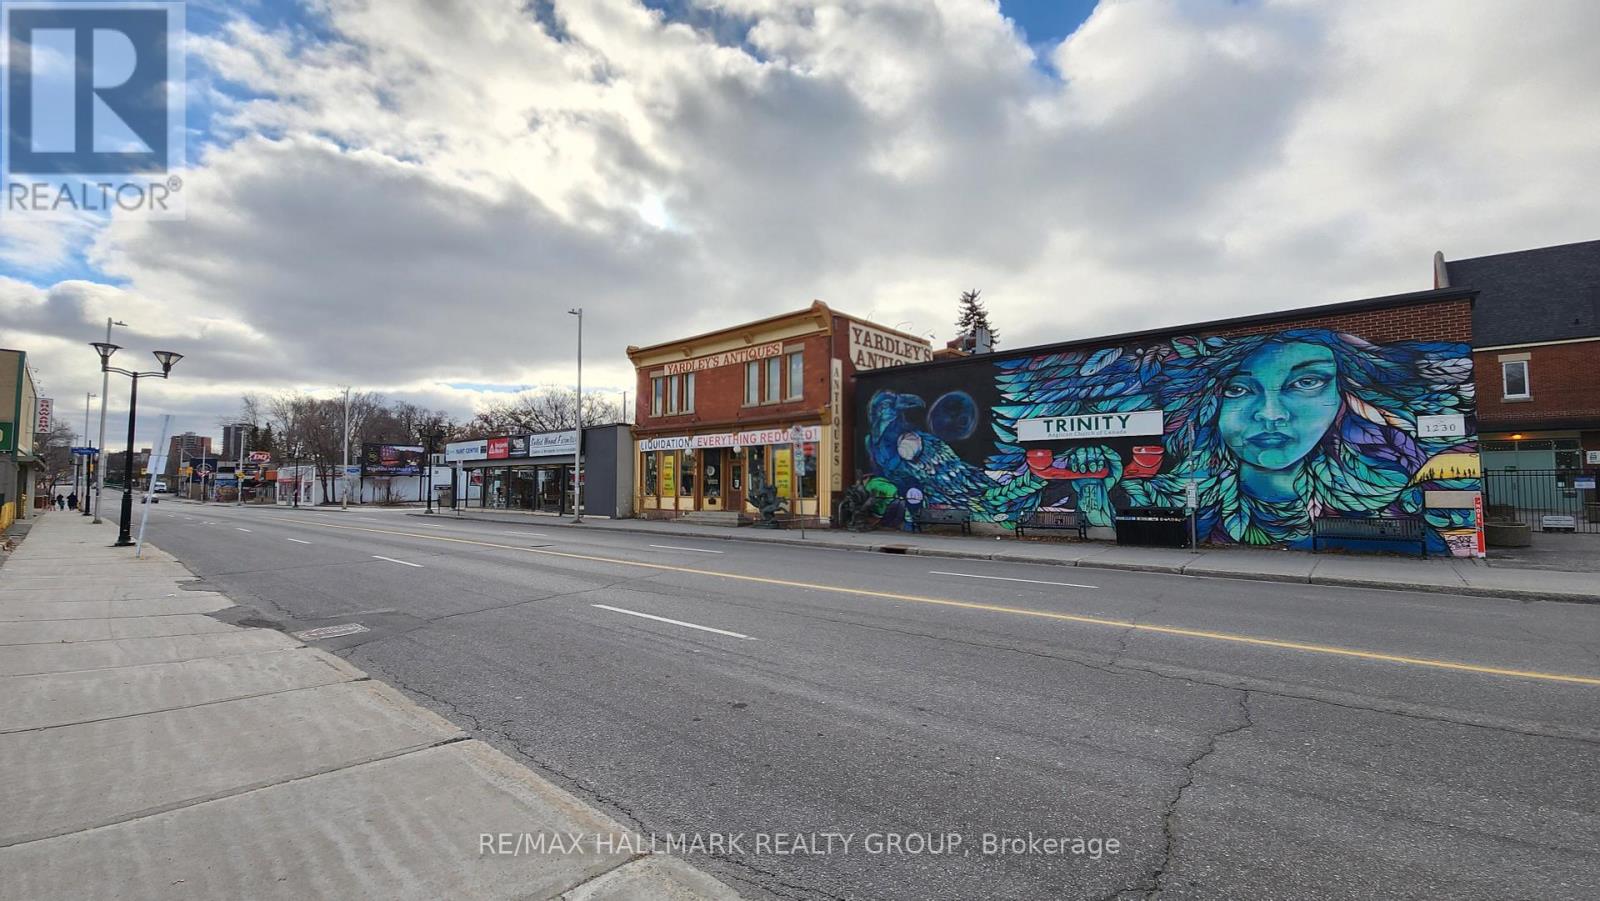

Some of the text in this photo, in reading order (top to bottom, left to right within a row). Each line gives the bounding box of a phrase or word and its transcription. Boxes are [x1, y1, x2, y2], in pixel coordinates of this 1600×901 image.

[852, 327, 932, 362] YARDLEY'S
[667, 343, 780, 374] YARDLEY'S ANTIQUES
[1043, 415, 1131, 433] TRINITY
[1425, 423, 1456, 432] 1230
[697, 433, 757, 447] EVERYTHING
[760, 429, 817, 443] REDUD!
